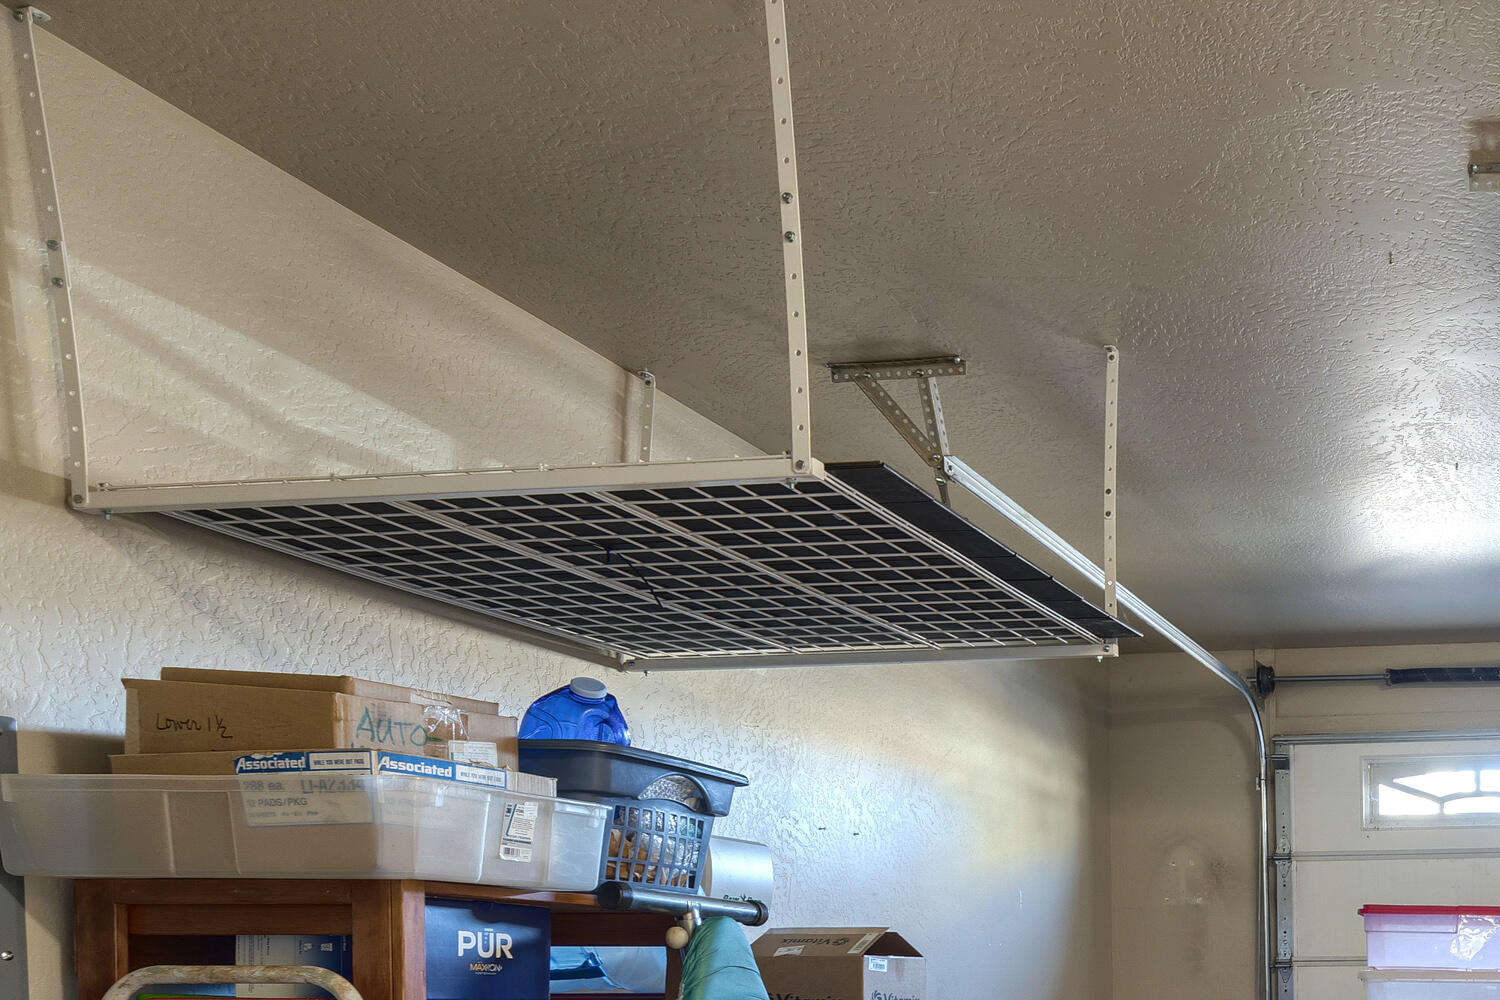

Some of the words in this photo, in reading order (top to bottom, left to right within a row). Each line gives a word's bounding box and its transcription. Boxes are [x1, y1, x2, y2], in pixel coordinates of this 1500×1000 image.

[155, 713, 201, 732] Lower
[236, 756, 307, 774] Associated
[377, 756, 453, 779] Associated
